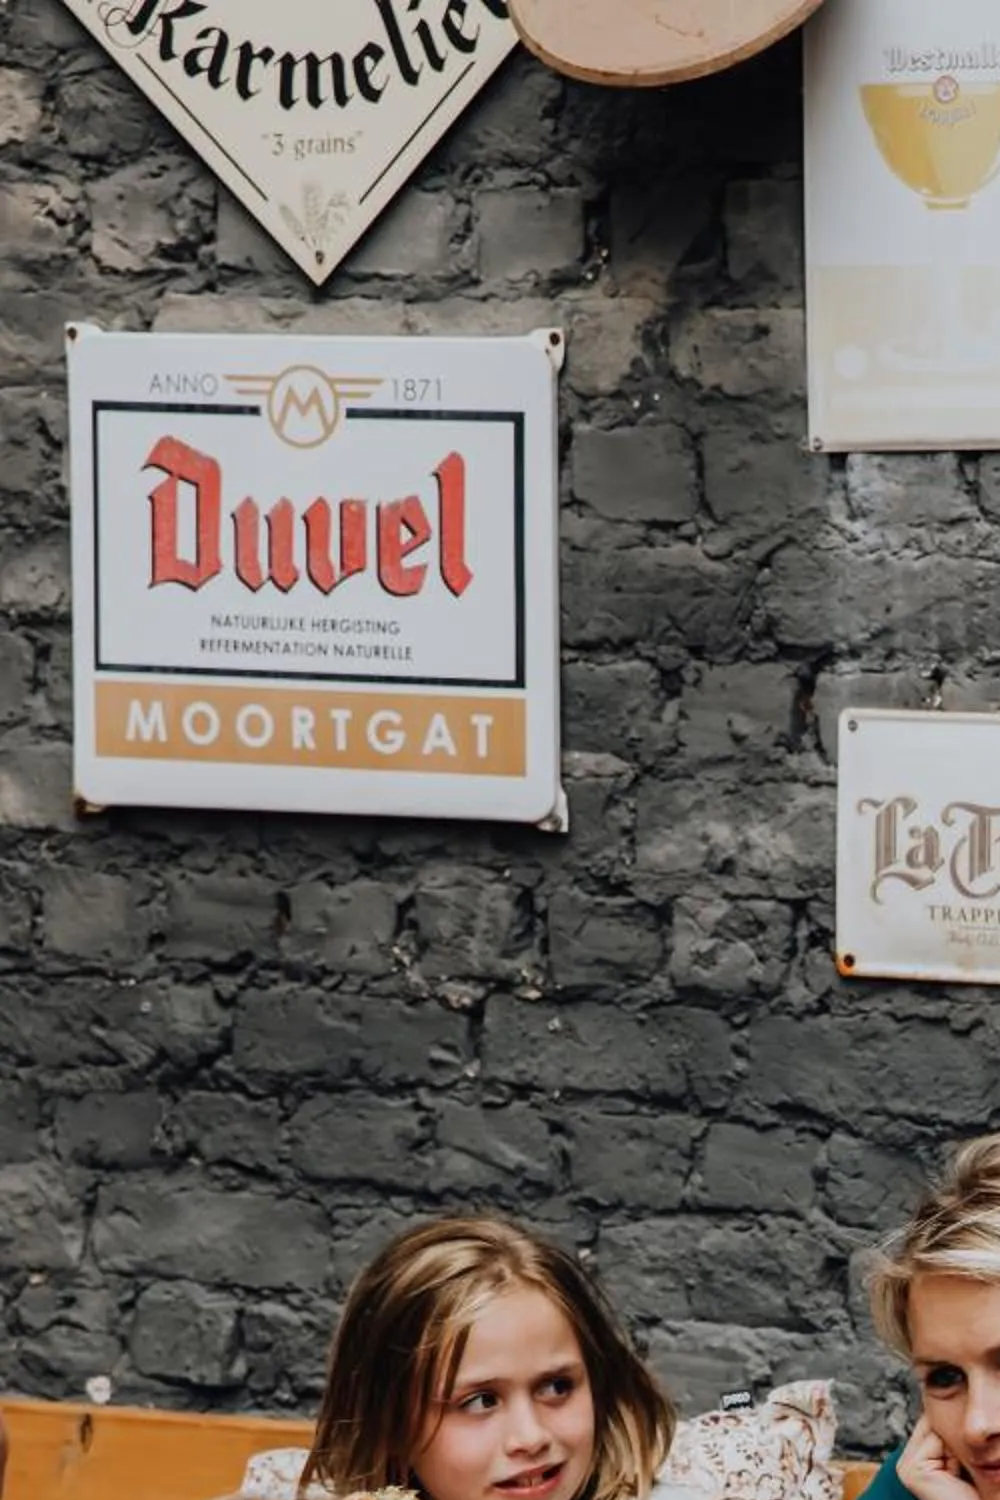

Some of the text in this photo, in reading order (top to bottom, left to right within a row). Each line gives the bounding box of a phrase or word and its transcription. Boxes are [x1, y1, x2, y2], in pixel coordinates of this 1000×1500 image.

[103, 0, 510, 110] Karmelie
[149, 373, 219, 397] ANNO
[391, 379, 443, 401] 1871
[141, 434, 474, 598] Duvel
[333, 644, 414, 661] NATURELLE
[125, 699, 496, 759] MOORTGAT
